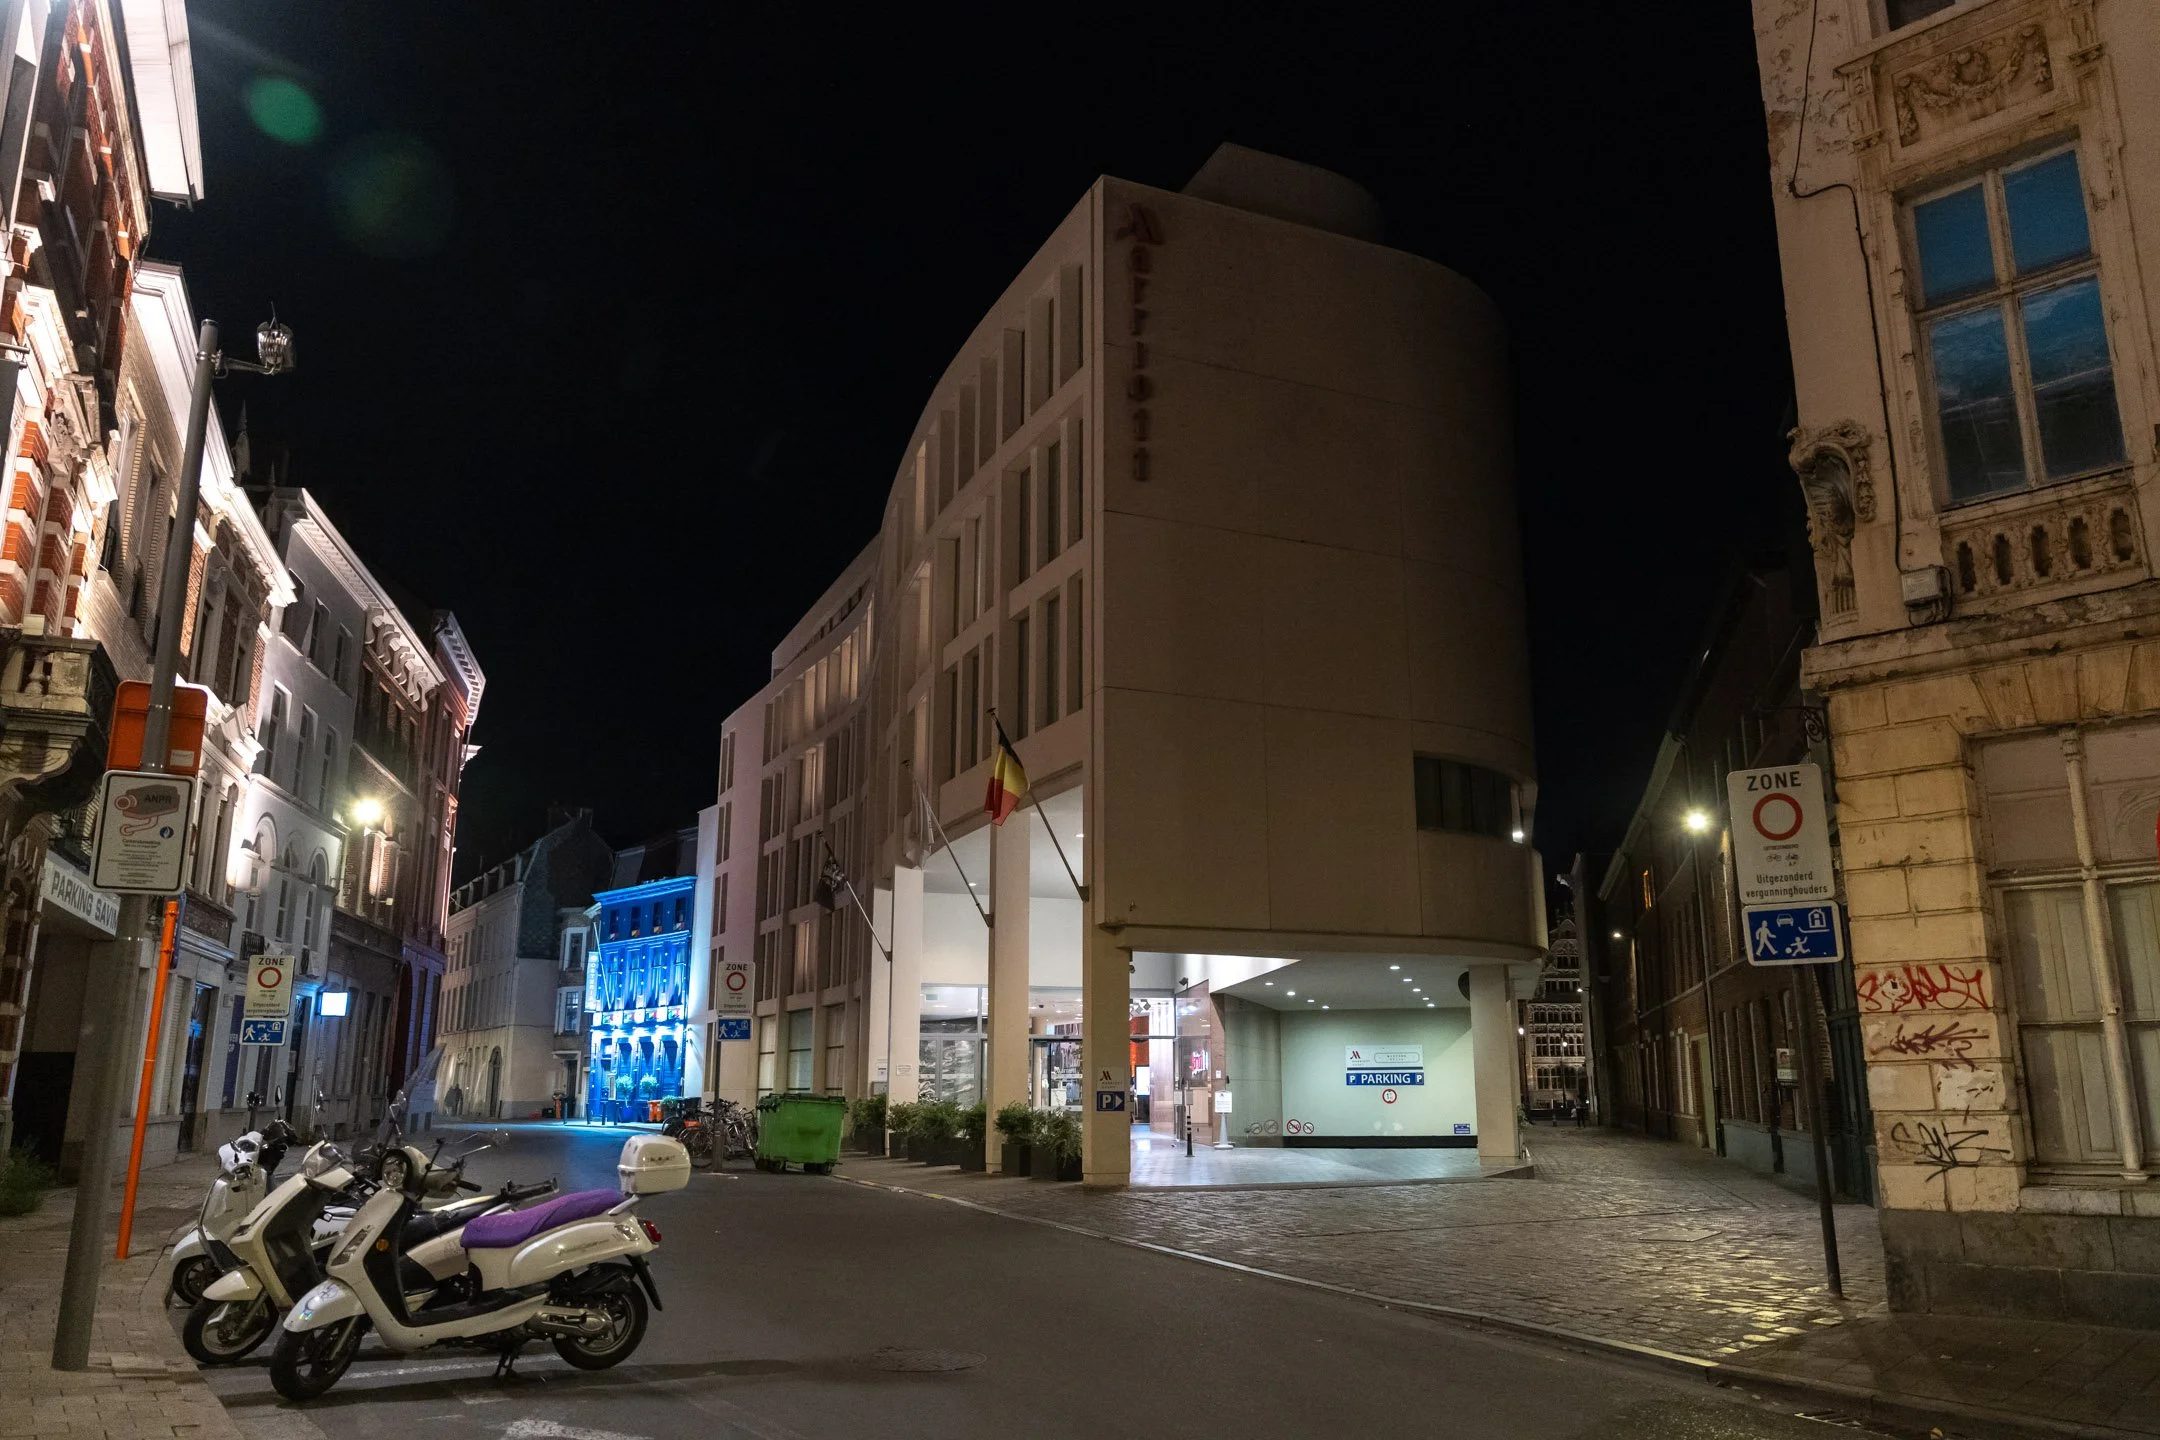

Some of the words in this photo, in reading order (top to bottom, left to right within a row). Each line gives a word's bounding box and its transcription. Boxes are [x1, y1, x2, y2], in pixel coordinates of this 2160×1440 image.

[1747, 771, 1801, 791] ZONE
[144, 794, 172, 804] ANPR
[1756, 871, 1813, 885] Uitgezonderd
[51, 870, 94, 917] PARKING
[1746, 887, 1828, 900] vergunninghouders
[258, 957, 285, 966] ZONE
[726, 963, 748, 971] ZONE
[1349, 1075, 1356, 1083] P
[1361, 1073, 1411, 1084] PARKING
[1416, 1074, 1423, 1083] P
[1102, 1094, 1112, 1109] P
